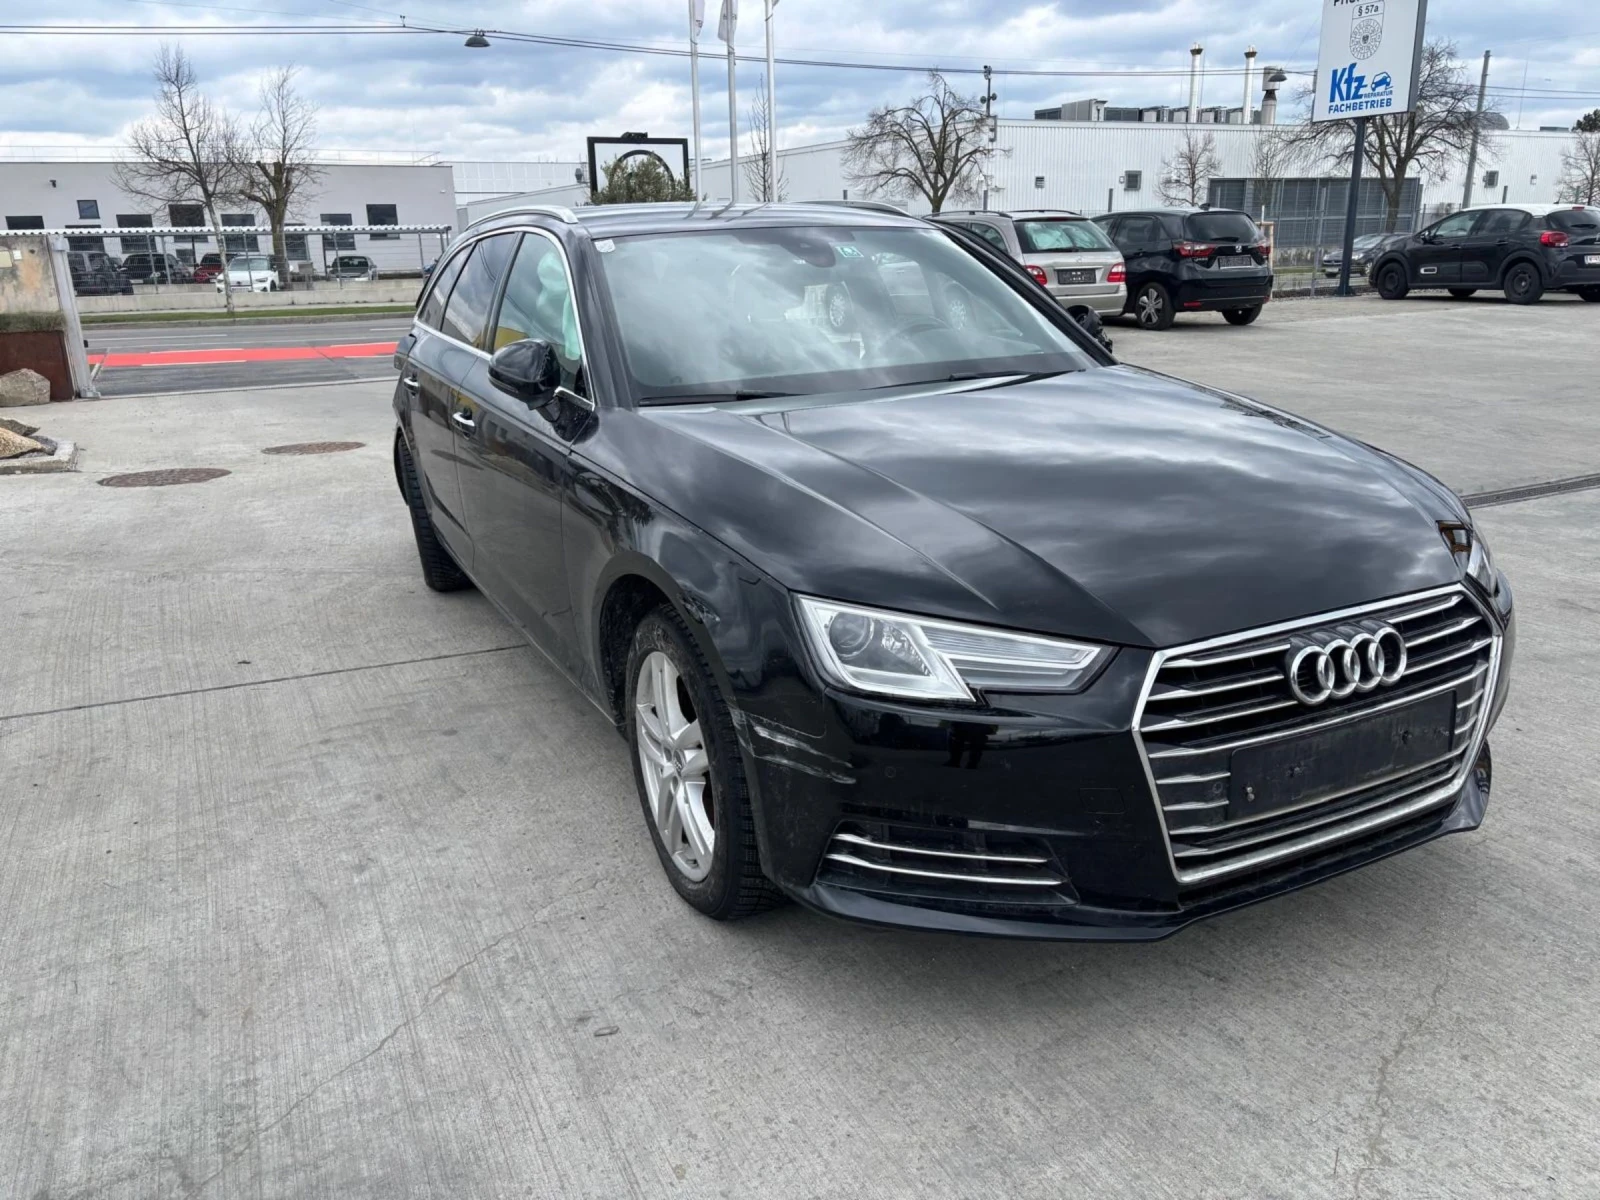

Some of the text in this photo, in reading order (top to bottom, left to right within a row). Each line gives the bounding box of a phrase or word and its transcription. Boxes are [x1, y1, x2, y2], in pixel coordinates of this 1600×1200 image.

[1358, 4, 1379, 17] § 57a
[1329, 62, 1368, 103] Kfz
[1364, 90, 1393, 99] REPARATUR
[1328, 98, 1392, 114] FACHBETRIEB
